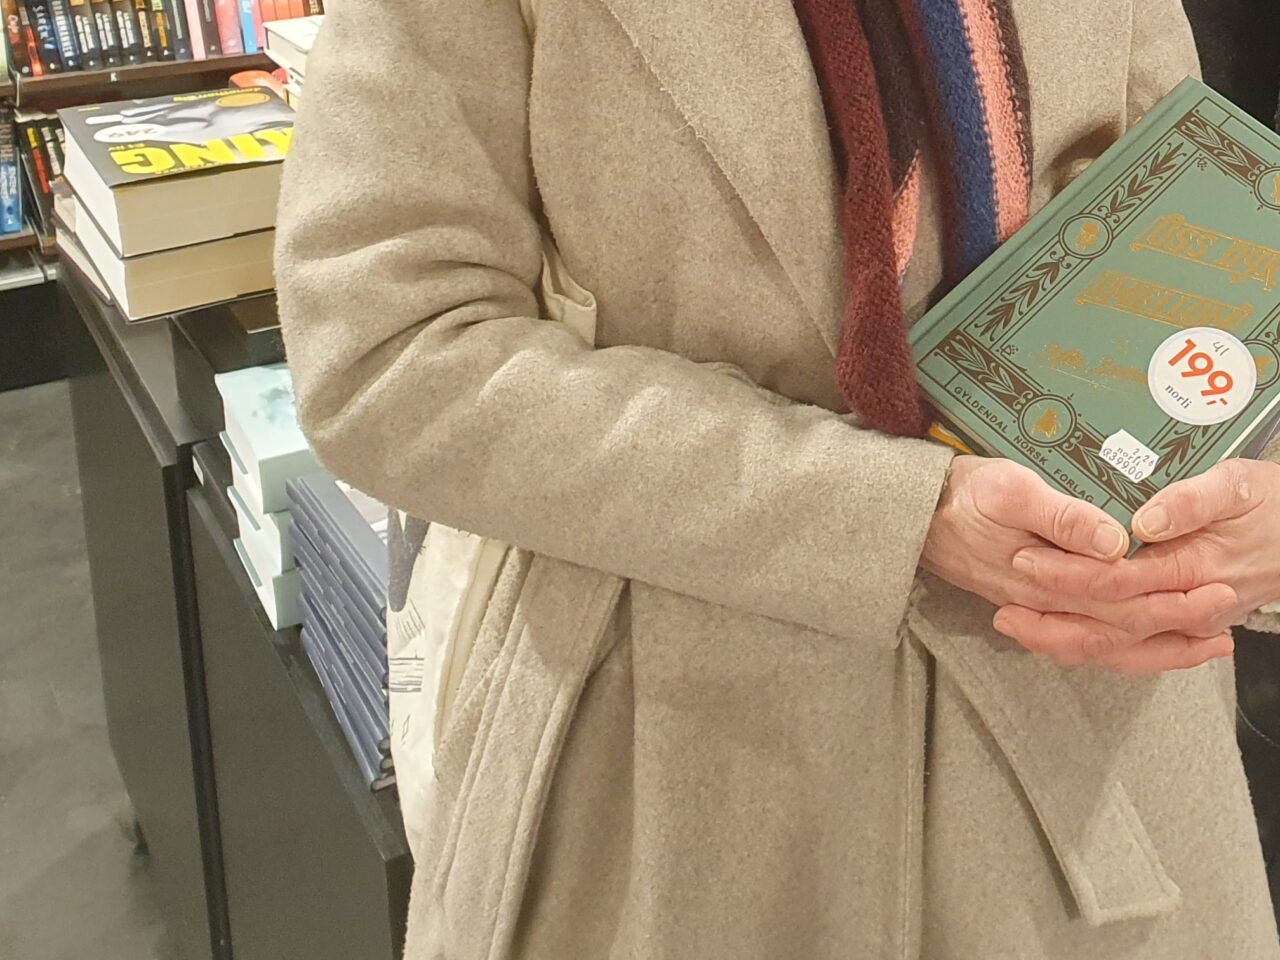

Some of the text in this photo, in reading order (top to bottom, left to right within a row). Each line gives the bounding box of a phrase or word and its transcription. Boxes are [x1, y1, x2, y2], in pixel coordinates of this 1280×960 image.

[1164, 384, 1193, 411] norli
[954, 386, 1095, 504] GYLDENDAL NORSK FORLAG
[1117, 447, 1141, 466] norli
